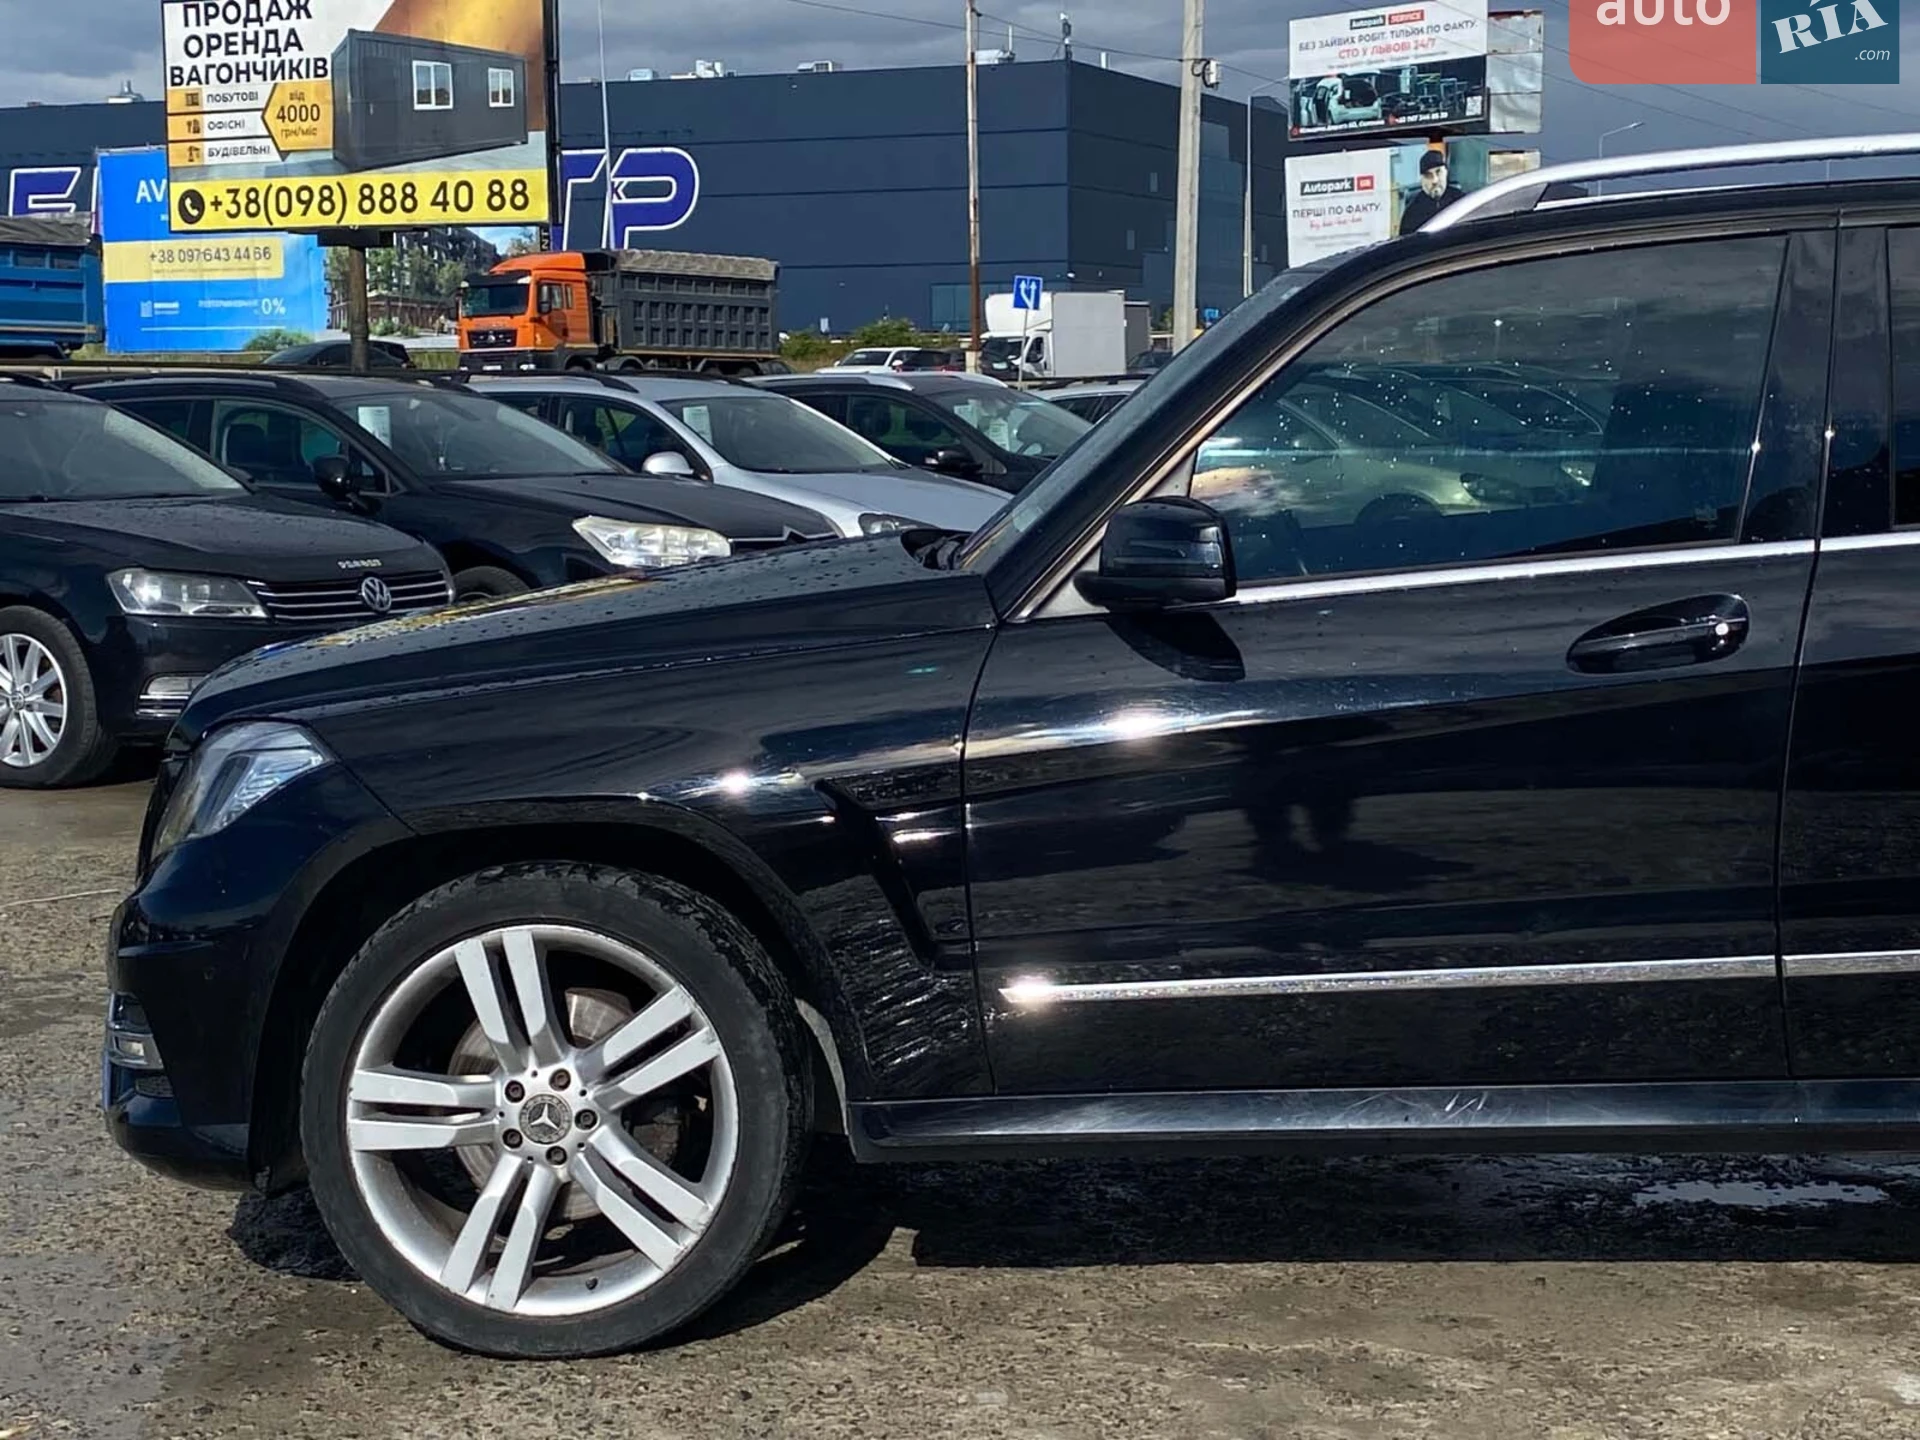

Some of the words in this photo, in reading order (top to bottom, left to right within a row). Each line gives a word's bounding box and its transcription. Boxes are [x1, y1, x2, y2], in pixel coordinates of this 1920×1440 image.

[183, 0, 312, 28] ПРОДАЖ
[1427, 25, 1440, 35] ПО
[183, 28, 303, 58] ОРЕНДА
[1338, 48, 1360, 59] СТО
[1370, 42, 1411, 55] ЛЬВОВІ
[170, 57, 328, 87] ВАГОНЧИКІВ
[206, 91, 259, 103] ПОБУТОВІ
[289, 90, 305, 103] від
[276, 104, 320, 123] 4000
[207, 119, 245, 131] ОФІСНІ
[207, 145, 270, 158] БУДІВЕЛЬНІ
[1303, 178, 1352, 194] Autopark
[210, 181, 347, 225] +38(098)
[358, 182, 418, 214] 888
[430, 180, 474, 212] 40
[486, 178, 530, 211] 88
[1292, 206, 1326, 218] ПЕРШІ
[1328, 205, 1343, 215] ПО
[150, 248, 175, 264] +38
[178, 248, 201, 263] 097
[203, 247, 231, 262] 643
[233, 246, 250, 260] 44
[261, 297, 286, 315] 0%
